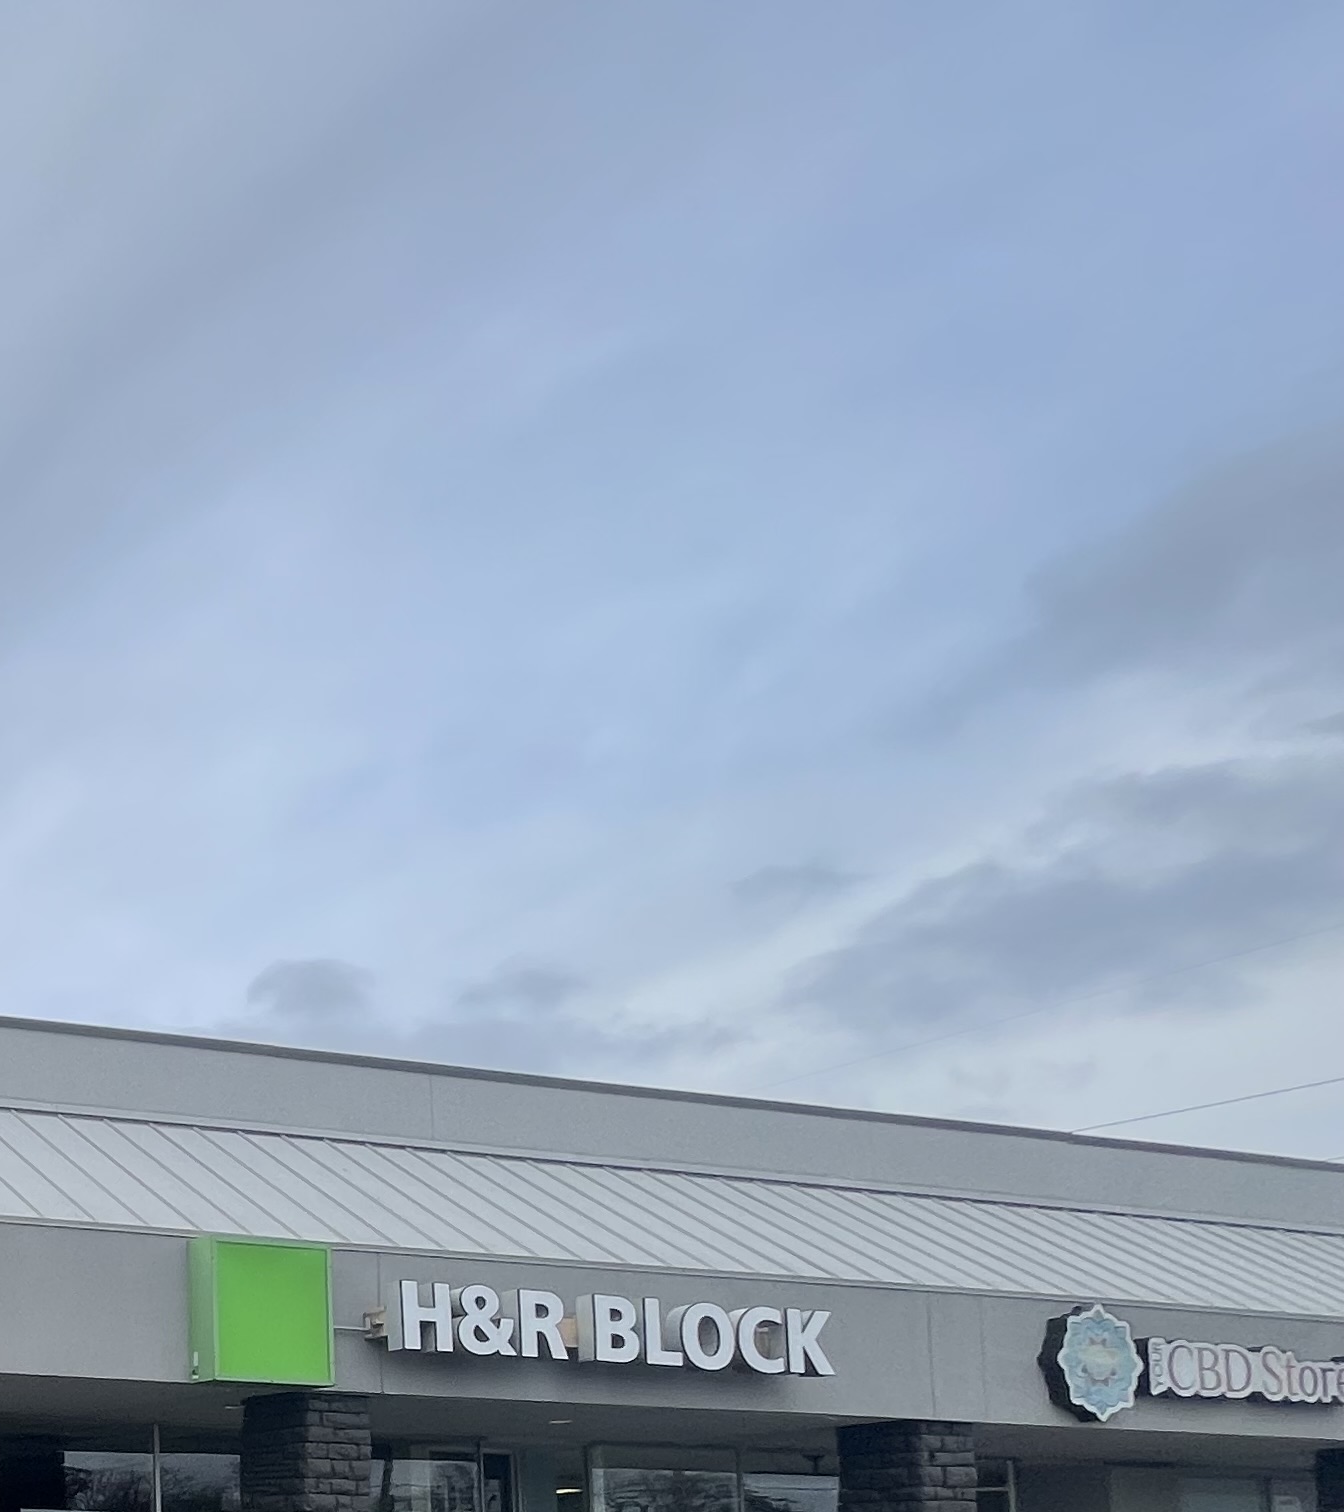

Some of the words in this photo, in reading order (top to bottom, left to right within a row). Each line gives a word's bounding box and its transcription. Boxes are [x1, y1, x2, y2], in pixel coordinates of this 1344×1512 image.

[398, 1279, 569, 1361] H&R
[592, 1293, 837, 1377] BLOCK
[1150, 1339, 1165, 1390] YOUR
[1167, 1344, 1252, 1393] CBD
